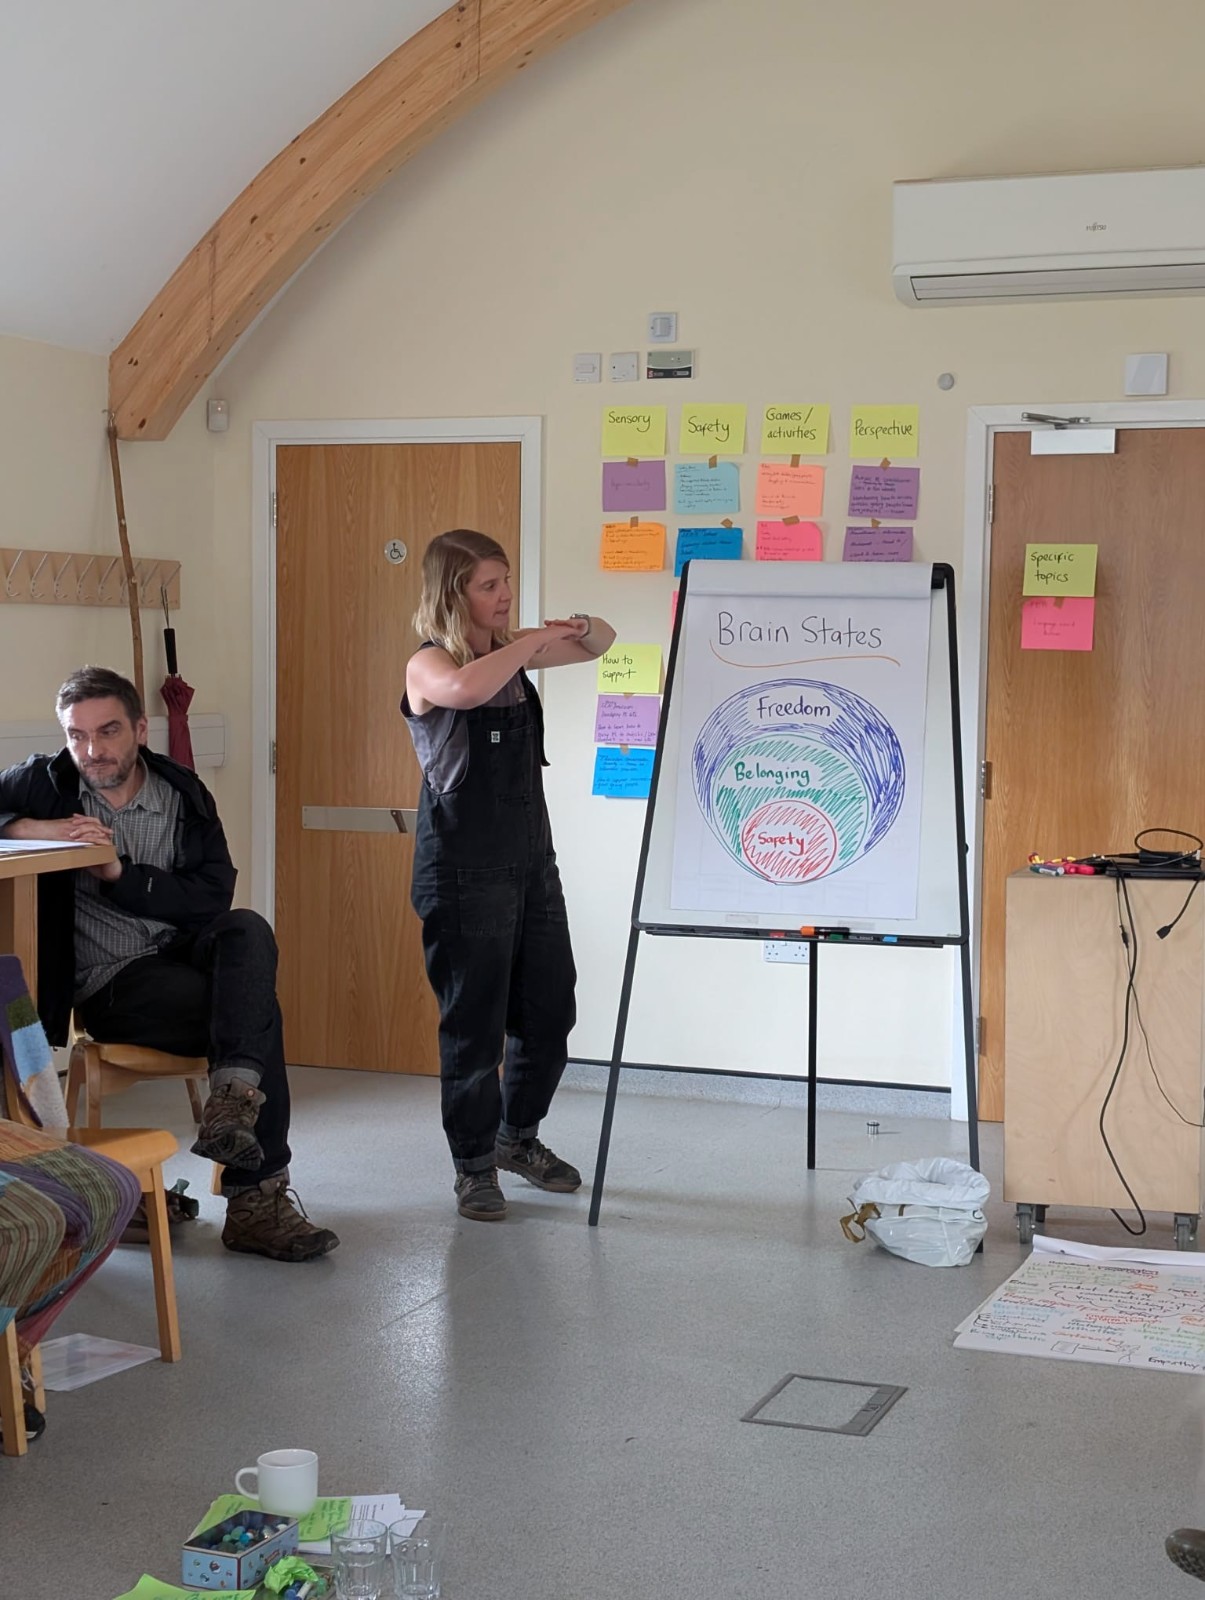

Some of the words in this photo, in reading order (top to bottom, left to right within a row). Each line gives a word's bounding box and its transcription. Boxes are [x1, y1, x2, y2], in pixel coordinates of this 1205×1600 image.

[608, 411, 651, 433] Sensory
[688, 416, 730, 442] Safety
[767, 426, 817, 440] activities
[855, 418, 914, 440] Perspective
[1034, 569, 1069, 585] topics
[718, 611, 789, 646] Brain
[801, 615, 882, 649] States
[602, 654, 620, 665] How
[622, 654, 633, 665] to
[602, 669, 637, 683] support
[756, 695, 831, 719] Freedom
[734, 761, 811, 787] Belonging
[757, 831, 805, 856] Safety
